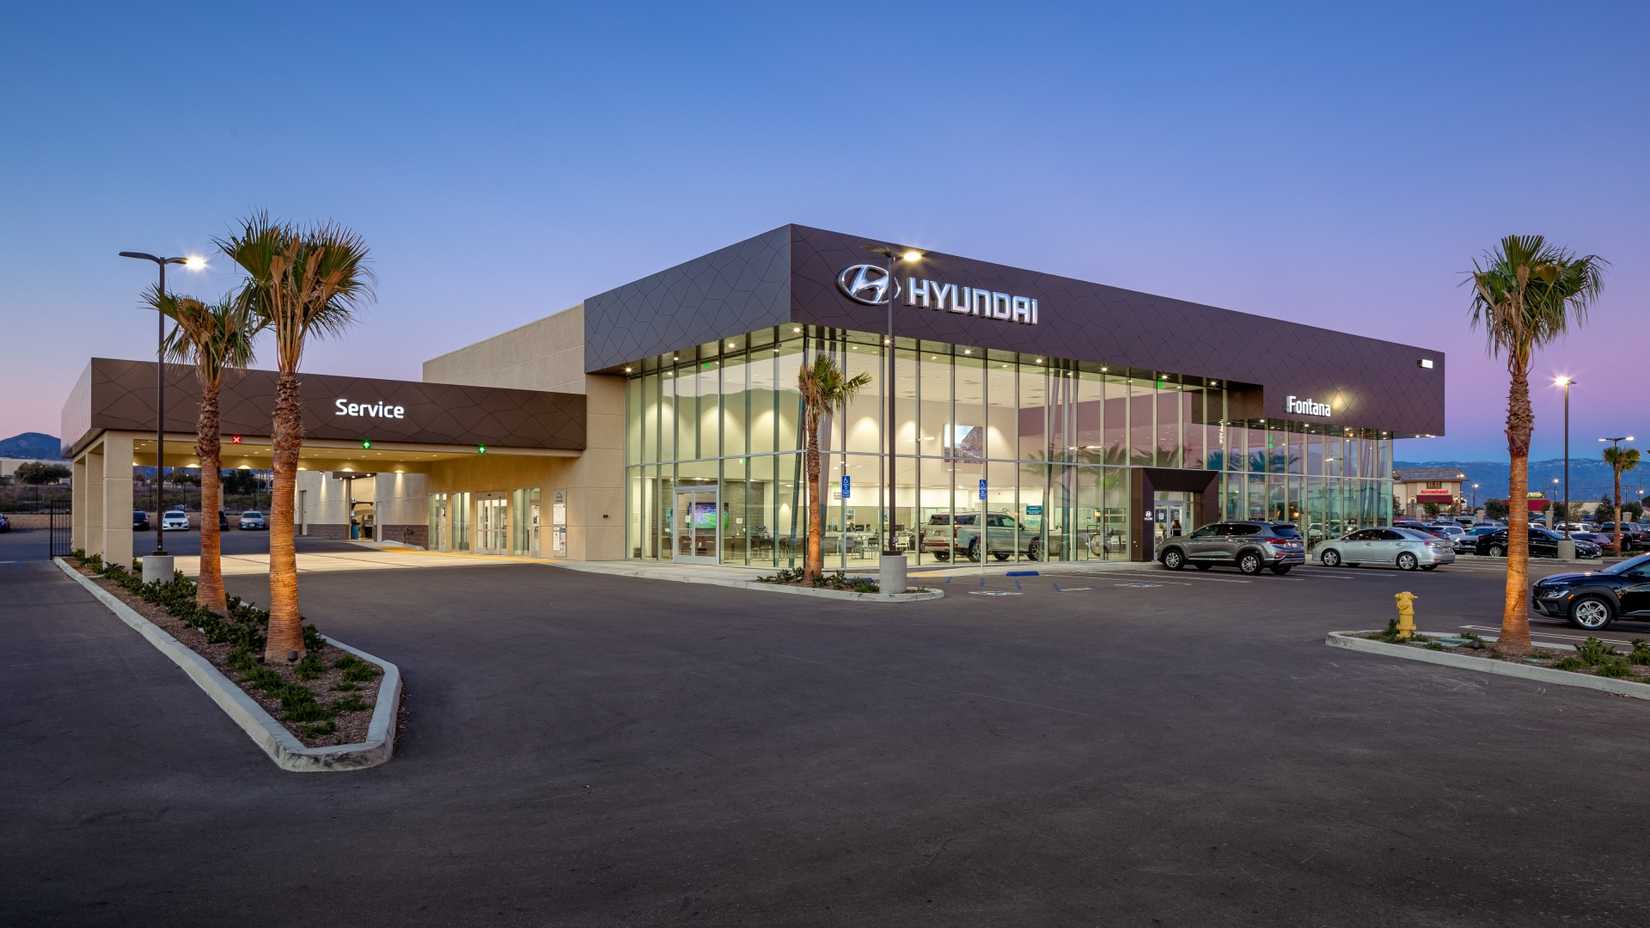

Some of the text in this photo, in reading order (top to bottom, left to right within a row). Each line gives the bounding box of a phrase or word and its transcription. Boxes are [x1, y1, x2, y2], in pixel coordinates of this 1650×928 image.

[907, 277, 1038, 325] HYUNDAI
[335, 399, 404, 419] Service
[1286, 395, 1331, 417] Fontana
